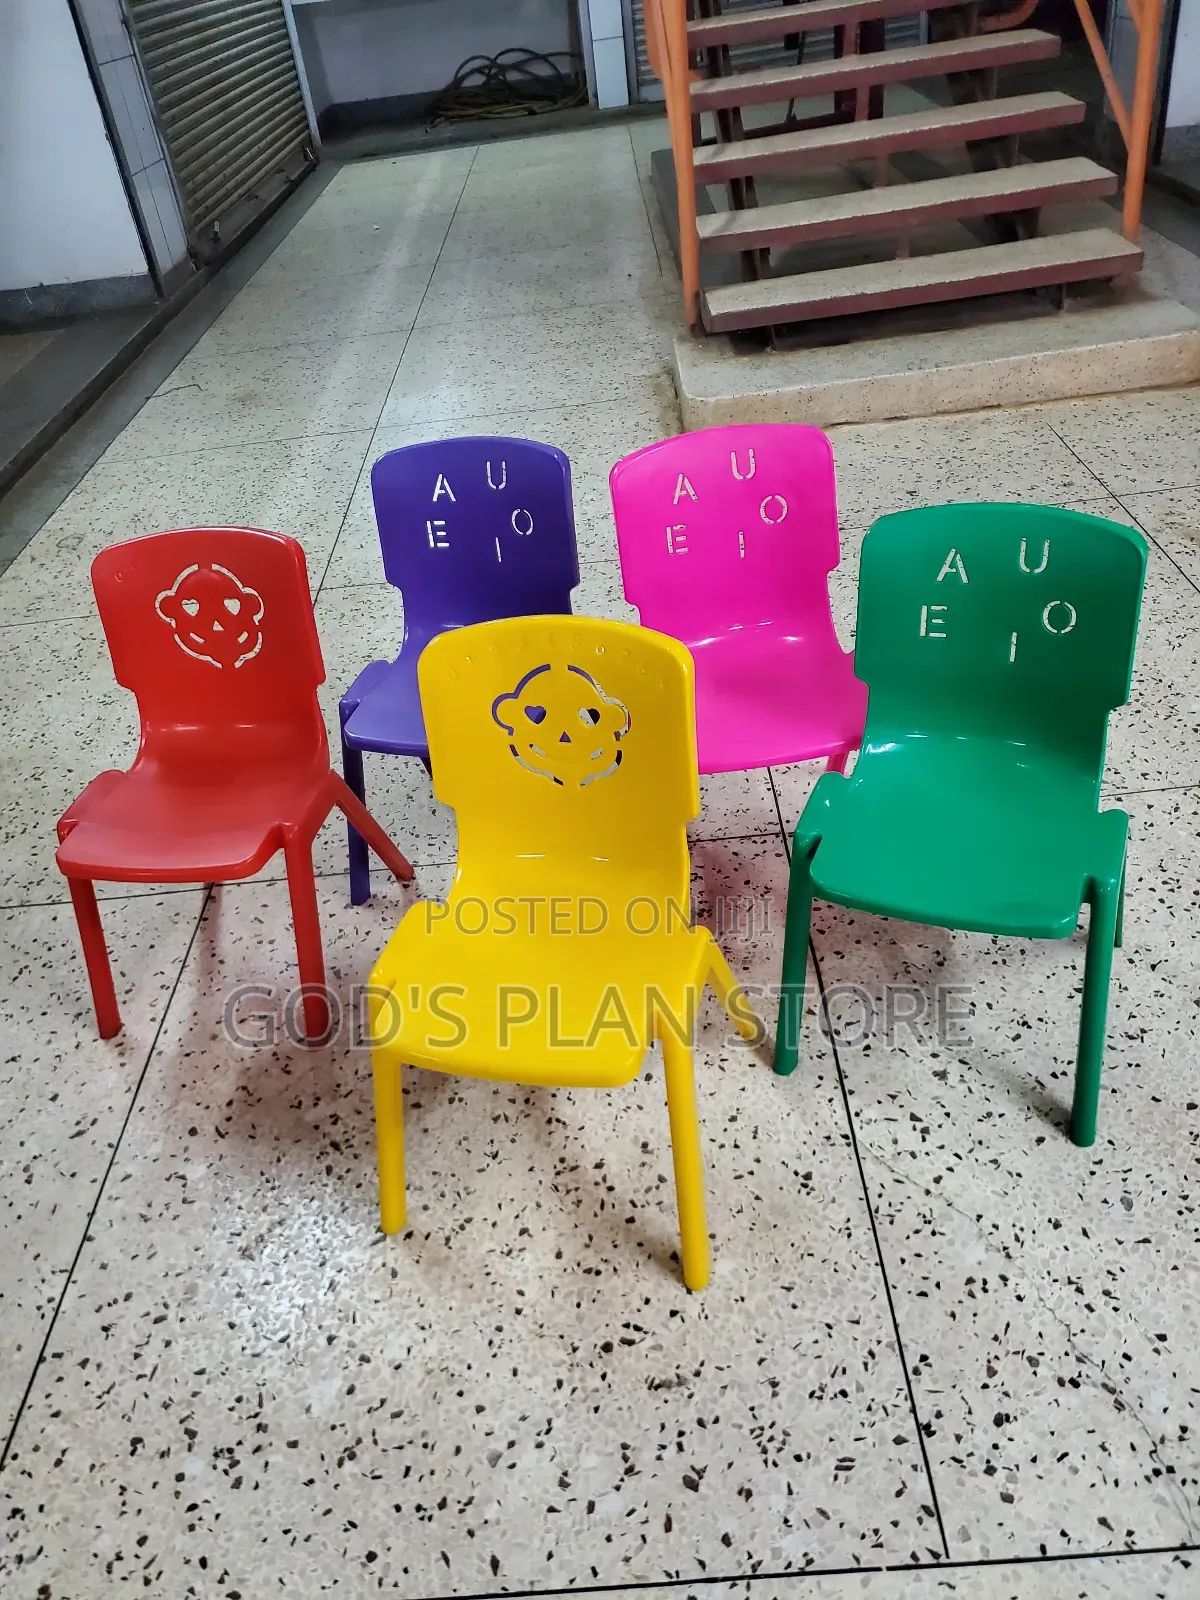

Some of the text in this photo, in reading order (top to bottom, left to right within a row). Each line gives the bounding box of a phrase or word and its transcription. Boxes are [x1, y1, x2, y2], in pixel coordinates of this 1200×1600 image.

[432, 461, 507, 502] A U
[672, 448, 756, 505] A U
[426, 520, 450, 548] E
[511, 508, 534, 536] O
[665, 524, 689, 555] E
[759, 494, 788, 524] O
[936, 537, 1050, 584] A U
[919, 604, 948, 638] E
[1042, 600, 1077, 634] O
